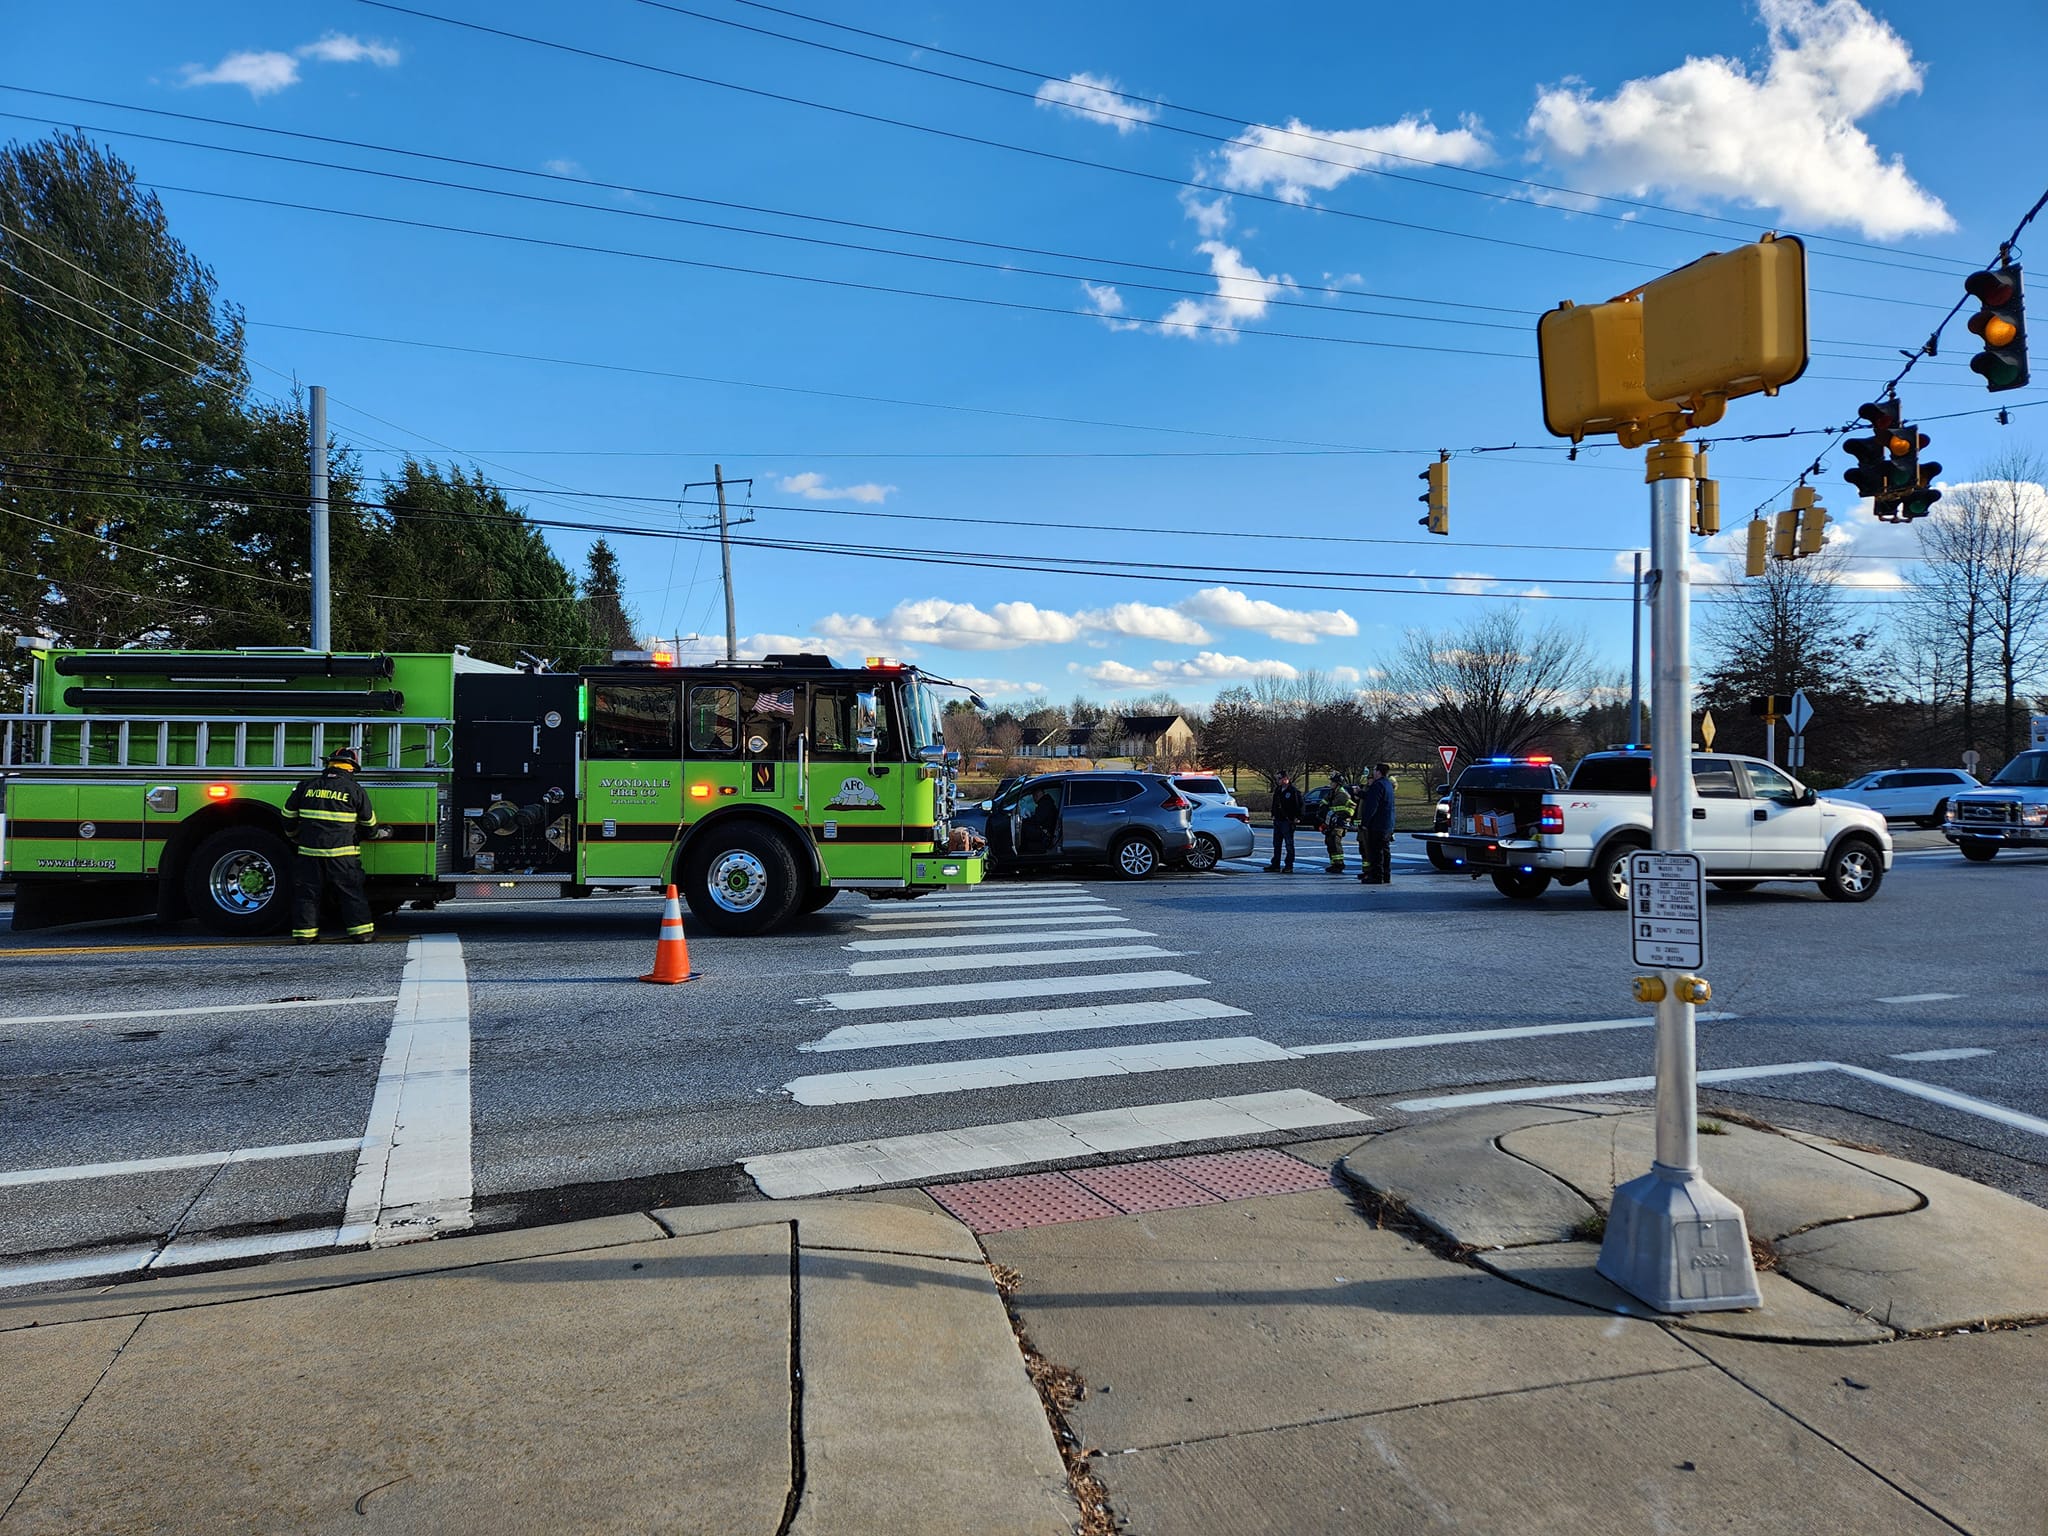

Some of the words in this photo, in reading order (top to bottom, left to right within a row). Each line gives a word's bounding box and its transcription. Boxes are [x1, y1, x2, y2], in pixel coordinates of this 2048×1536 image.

[599, 779, 670, 788] AVONDALE
[844, 780, 863, 790] AFC
[305, 788, 350, 802] AVONDALE
[610, 788, 637, 797] FIRE
[640, 788, 659, 797] CO.
[37, 858, 116, 870] www.afc23.org
